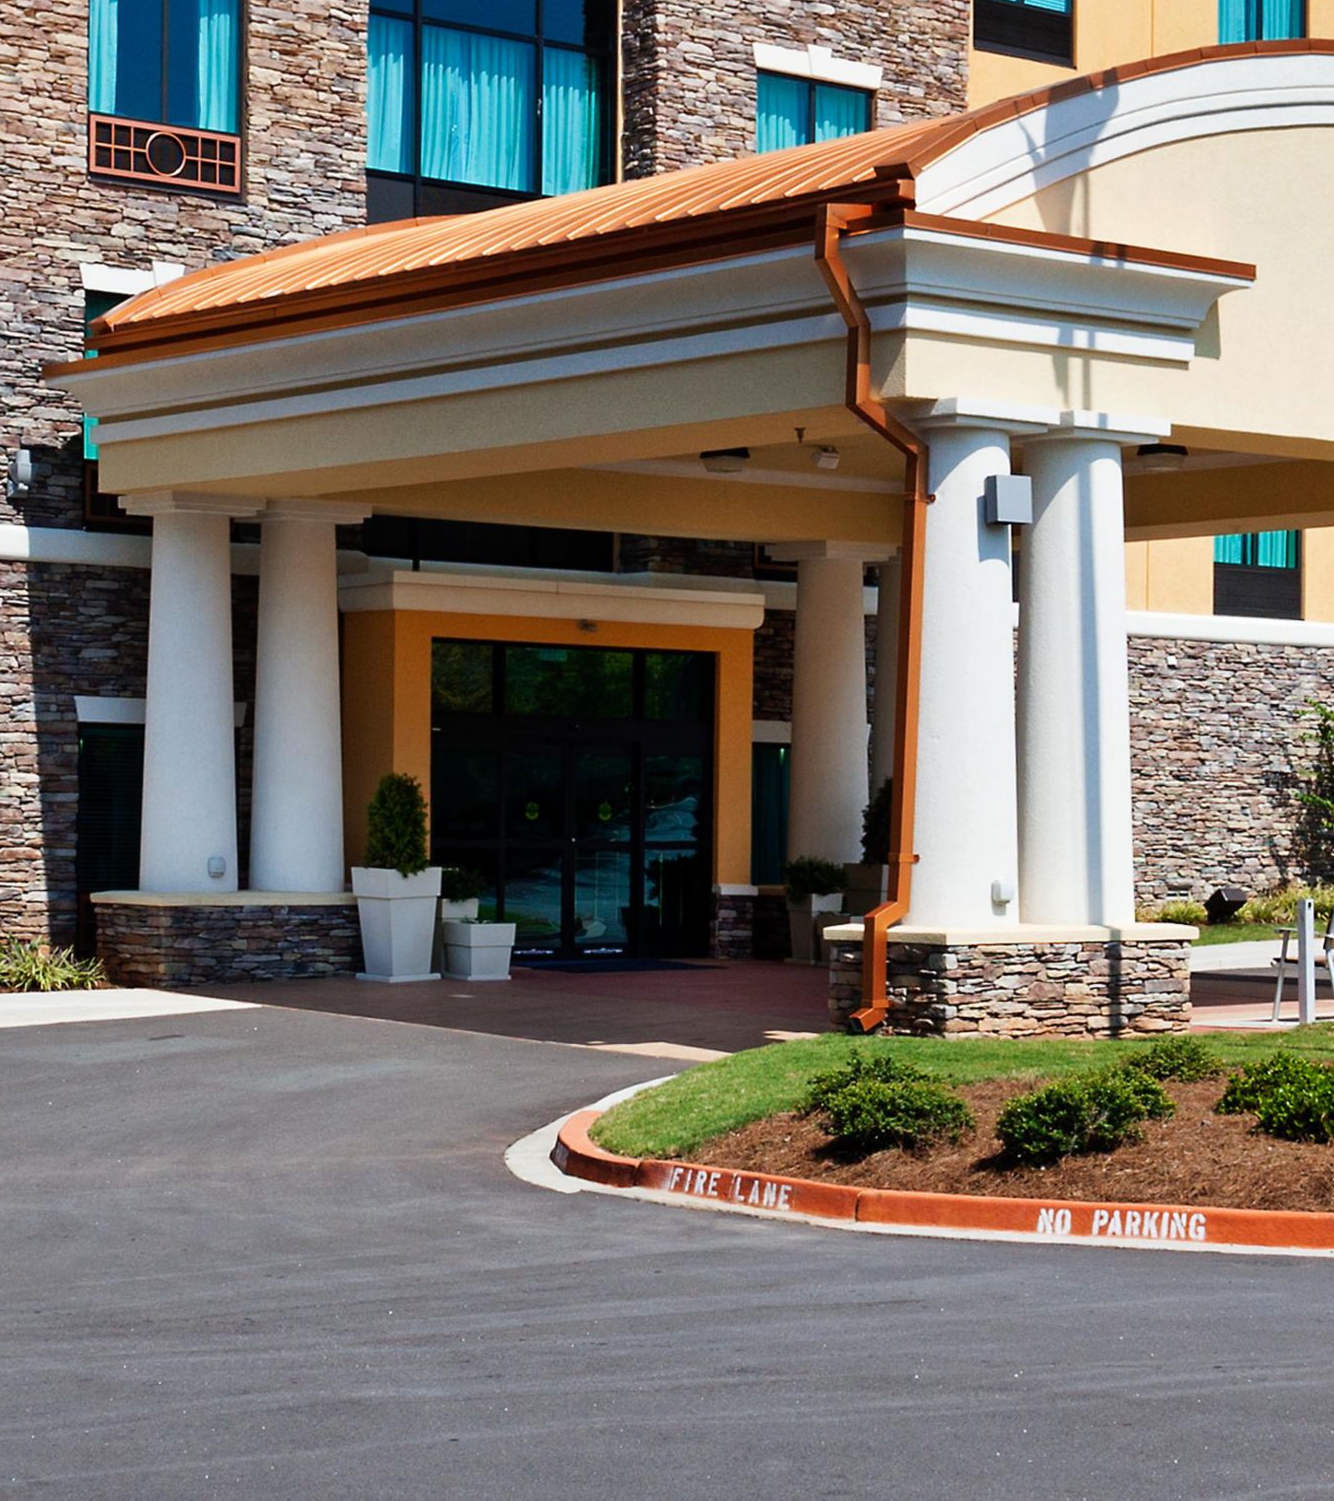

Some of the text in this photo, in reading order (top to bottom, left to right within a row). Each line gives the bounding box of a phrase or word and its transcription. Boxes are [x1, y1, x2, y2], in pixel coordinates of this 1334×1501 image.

[669, 1167, 792, 1210] FIRE LANE
[1037, 1208, 1207, 1241] NO PARKING
